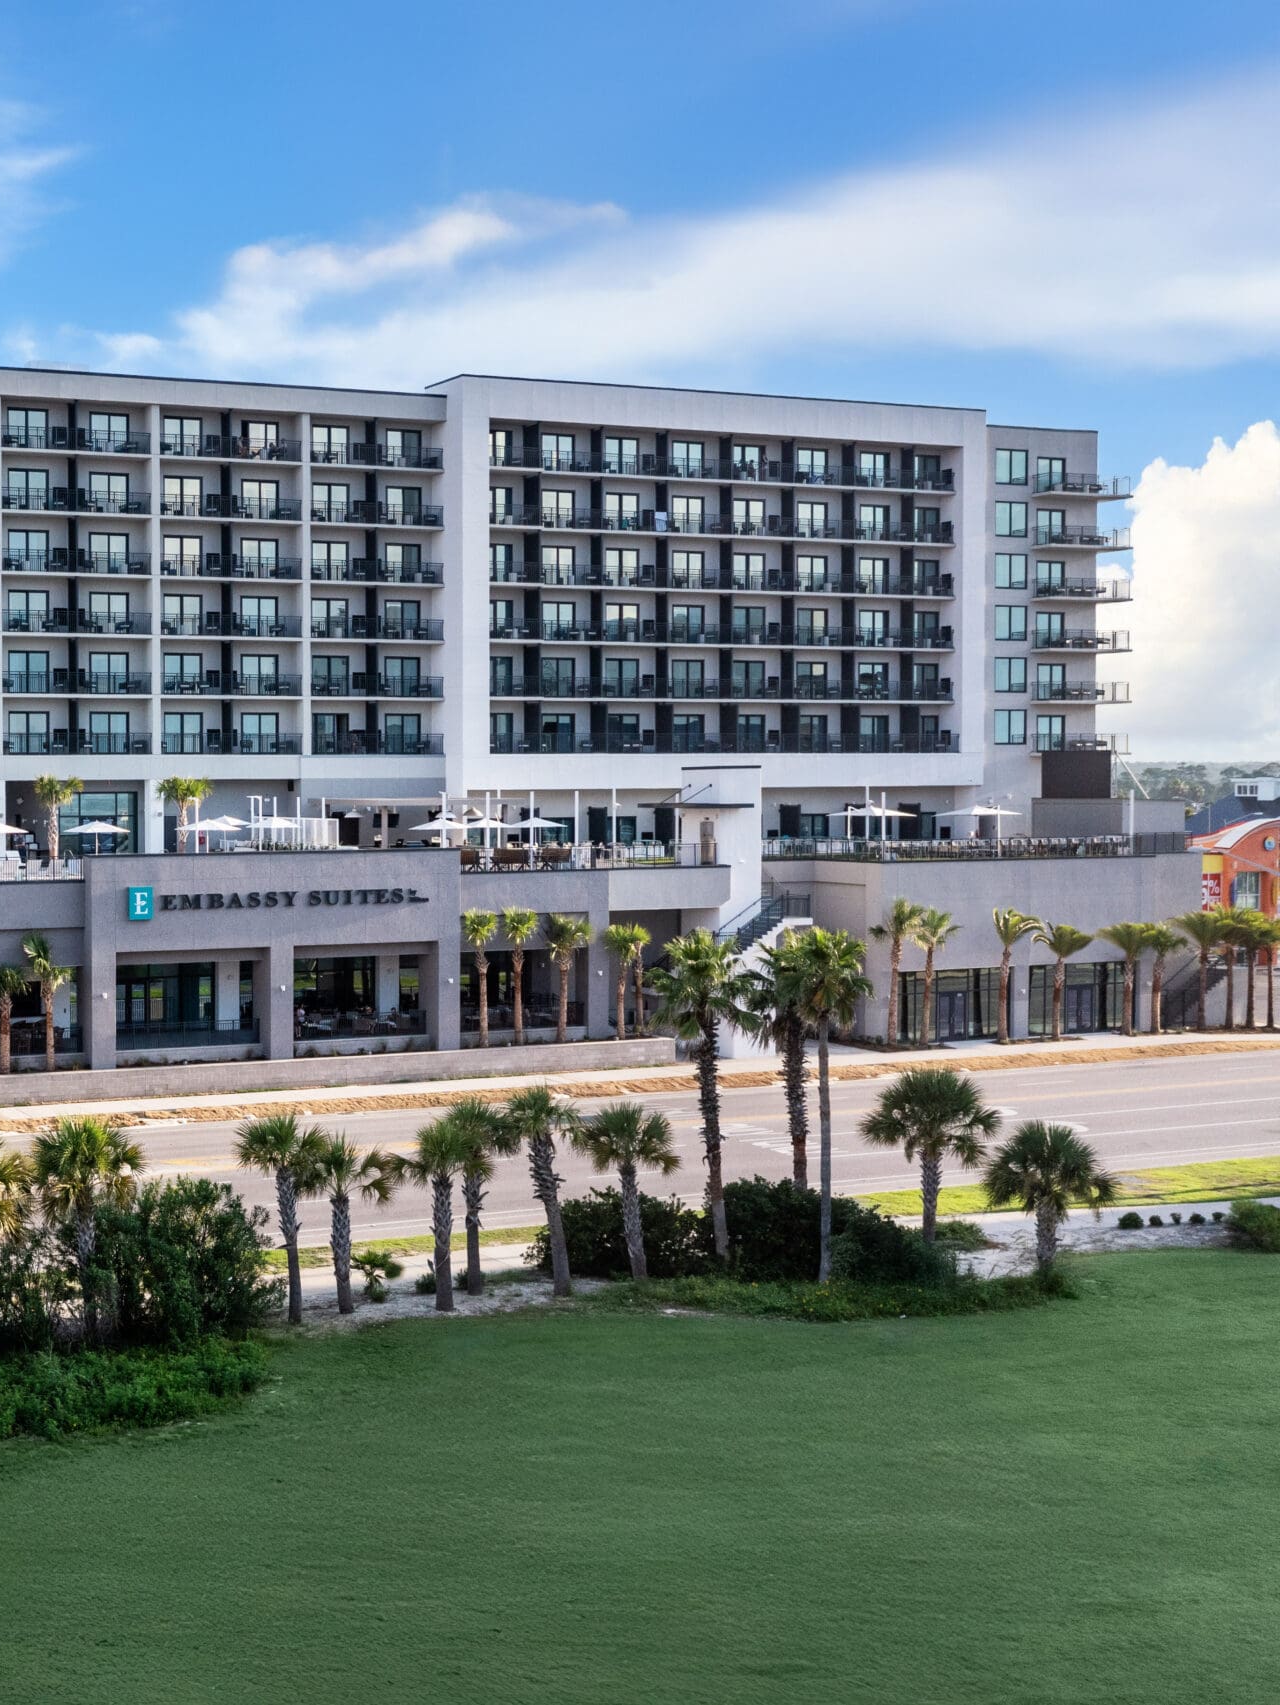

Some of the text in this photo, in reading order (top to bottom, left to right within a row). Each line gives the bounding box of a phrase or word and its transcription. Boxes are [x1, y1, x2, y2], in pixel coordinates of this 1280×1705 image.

[133, 891, 149, 915] E
[159, 890, 299, 911] EMBASSY
[308, 887, 404, 906] SUITES
